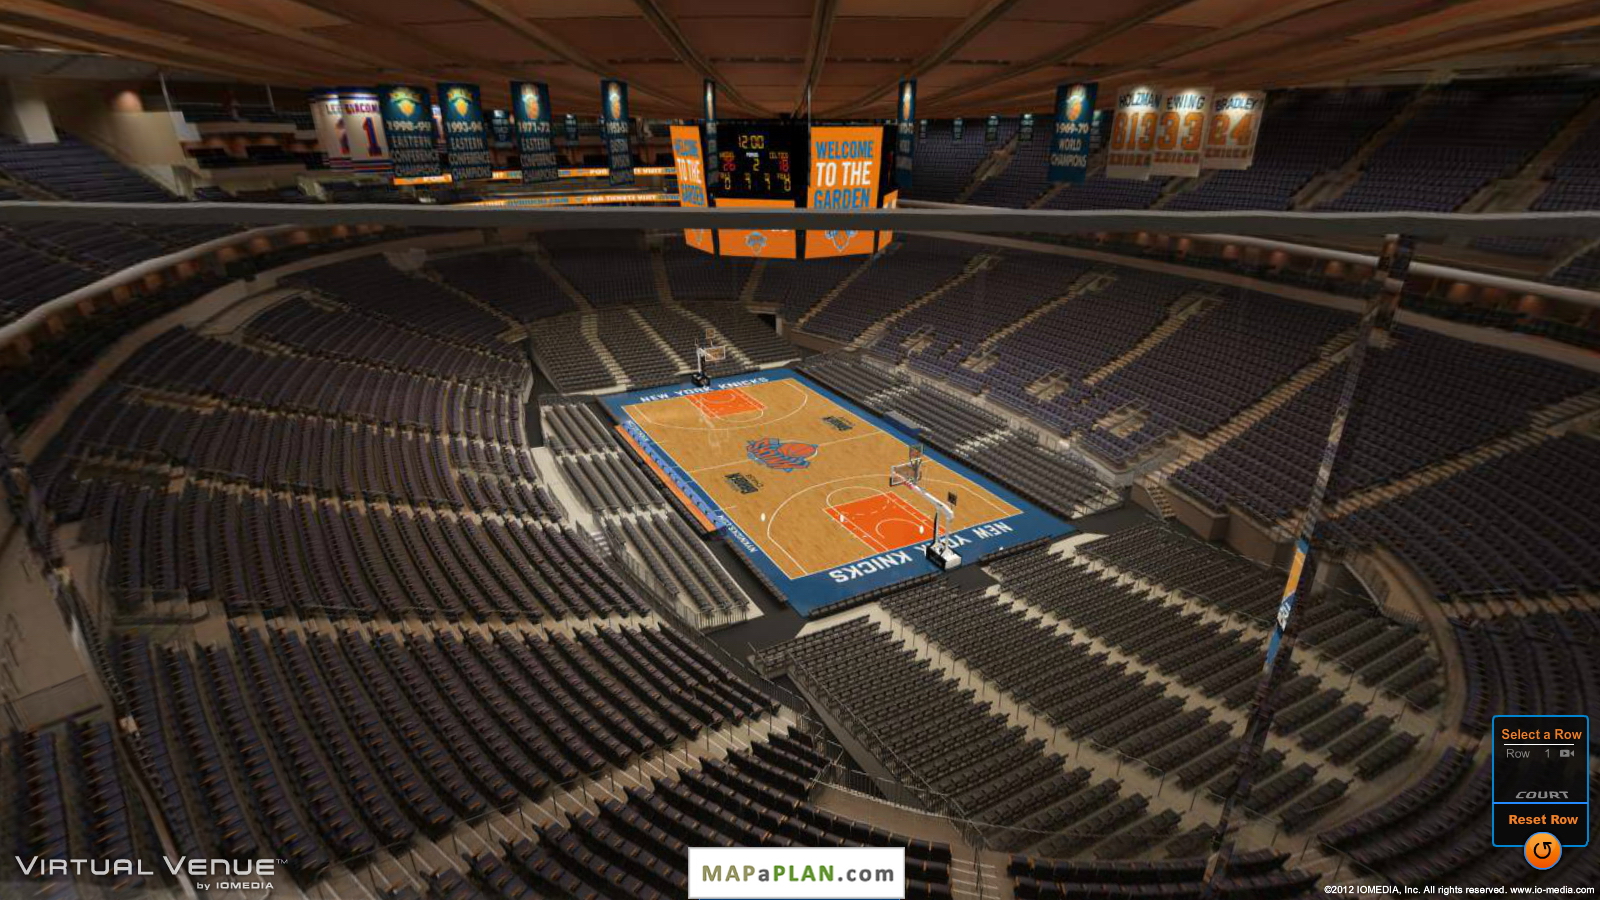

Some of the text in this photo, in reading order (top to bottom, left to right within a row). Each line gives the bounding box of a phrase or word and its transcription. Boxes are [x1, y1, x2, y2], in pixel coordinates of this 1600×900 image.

[1166, 93, 1205, 110] EWING
[1158, 112, 1204, 151] 33
[816, 141, 874, 159] WELCOME
[1058, 137, 1083, 151] WORLD
[816, 161, 837, 187] TO
[842, 161, 873, 186] THE
[814, 187, 871, 208] GARDEN
[640, 377, 770, 403] NEW YORK KNICKS
[971, 521, 1014, 539] NEW
[828, 550, 914, 583] KNICKS
